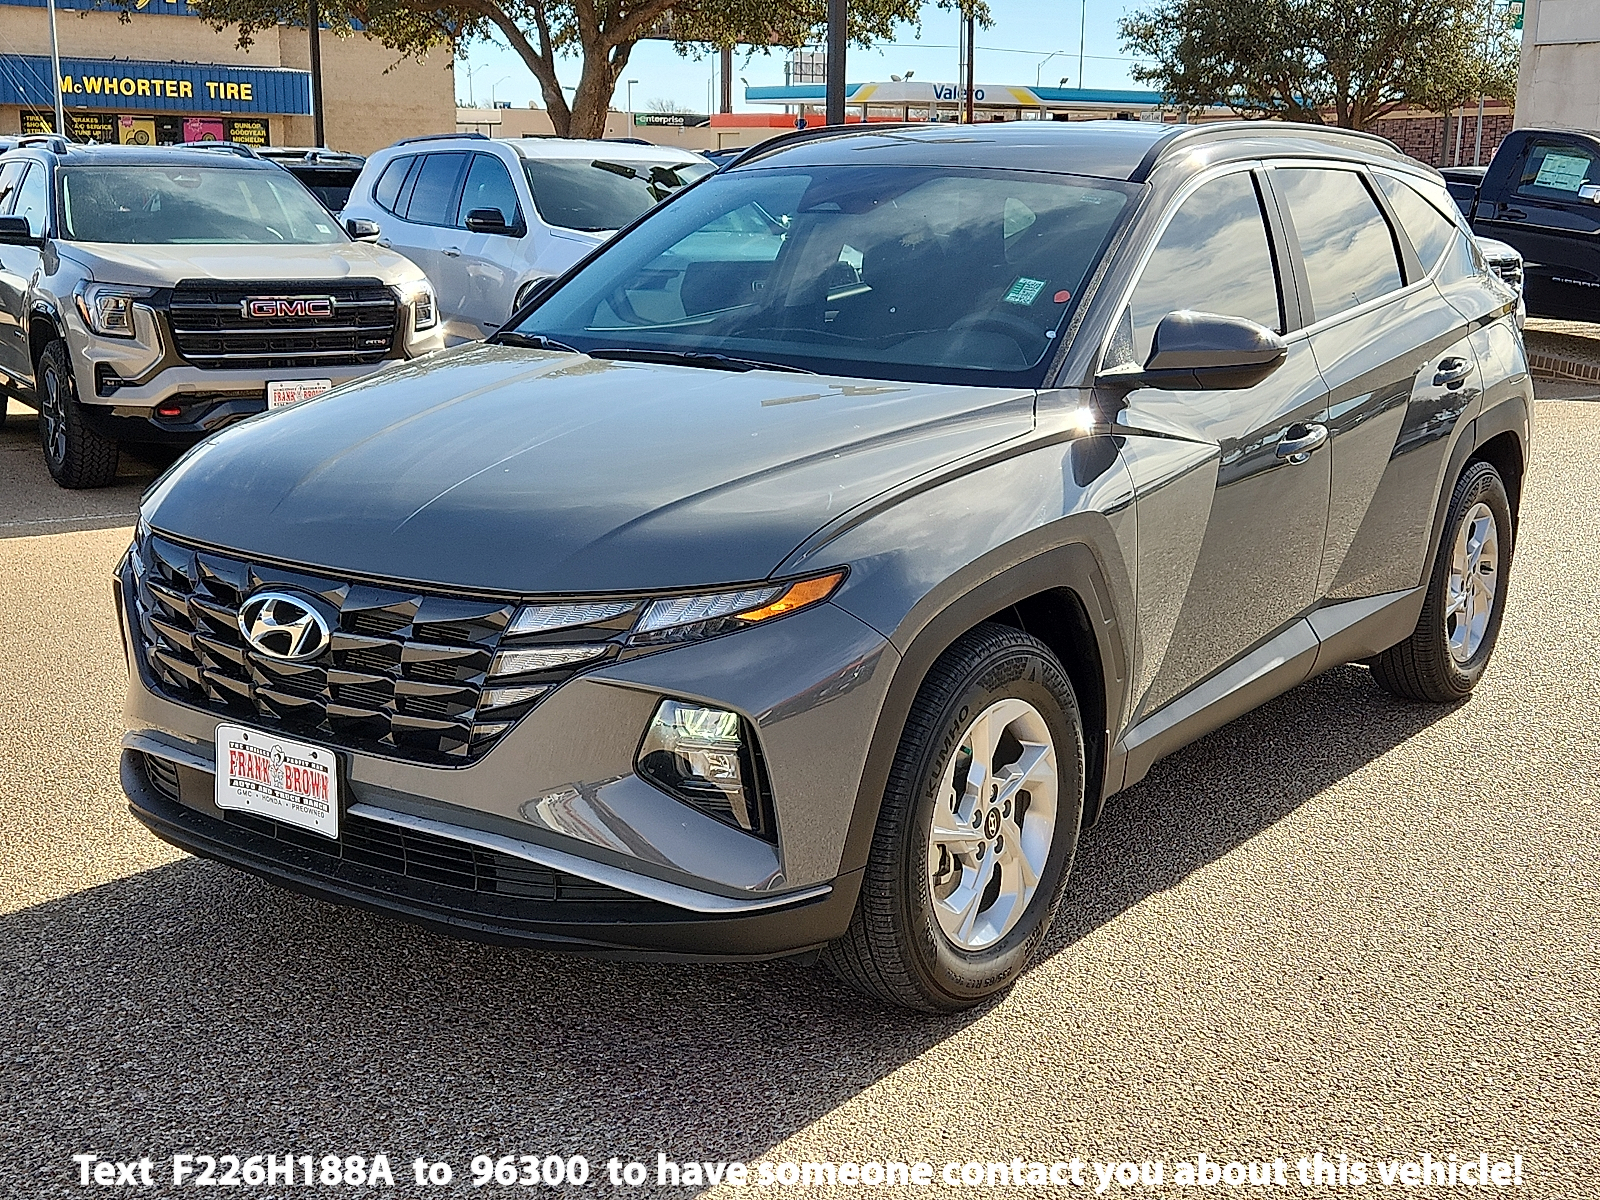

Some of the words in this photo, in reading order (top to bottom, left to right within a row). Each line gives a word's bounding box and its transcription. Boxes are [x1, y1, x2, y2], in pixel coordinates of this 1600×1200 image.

[59, 75, 193, 98] McWHORTER
[205, 81, 253, 101] TIRE
[933, 84, 985, 101] Valeo
[640, 115, 684, 125] enterprise
[250, 300, 331, 317] GMC
[273, 390, 297, 402] FRANK
[925, 704, 969, 801] KUMHO
[229, 749, 271, 785] FRANK
[284, 764, 329, 803] BROWN
[232, 779, 256, 791] AUTO
[258, 785, 273, 796] AND
[274, 790, 301, 803] TRUCK
[303, 797, 328, 812] RANCH
[237, 788, 253, 798] GMC
[261, 795, 283, 807] HONDA
[291, 803, 325, 819] PREOWNED
